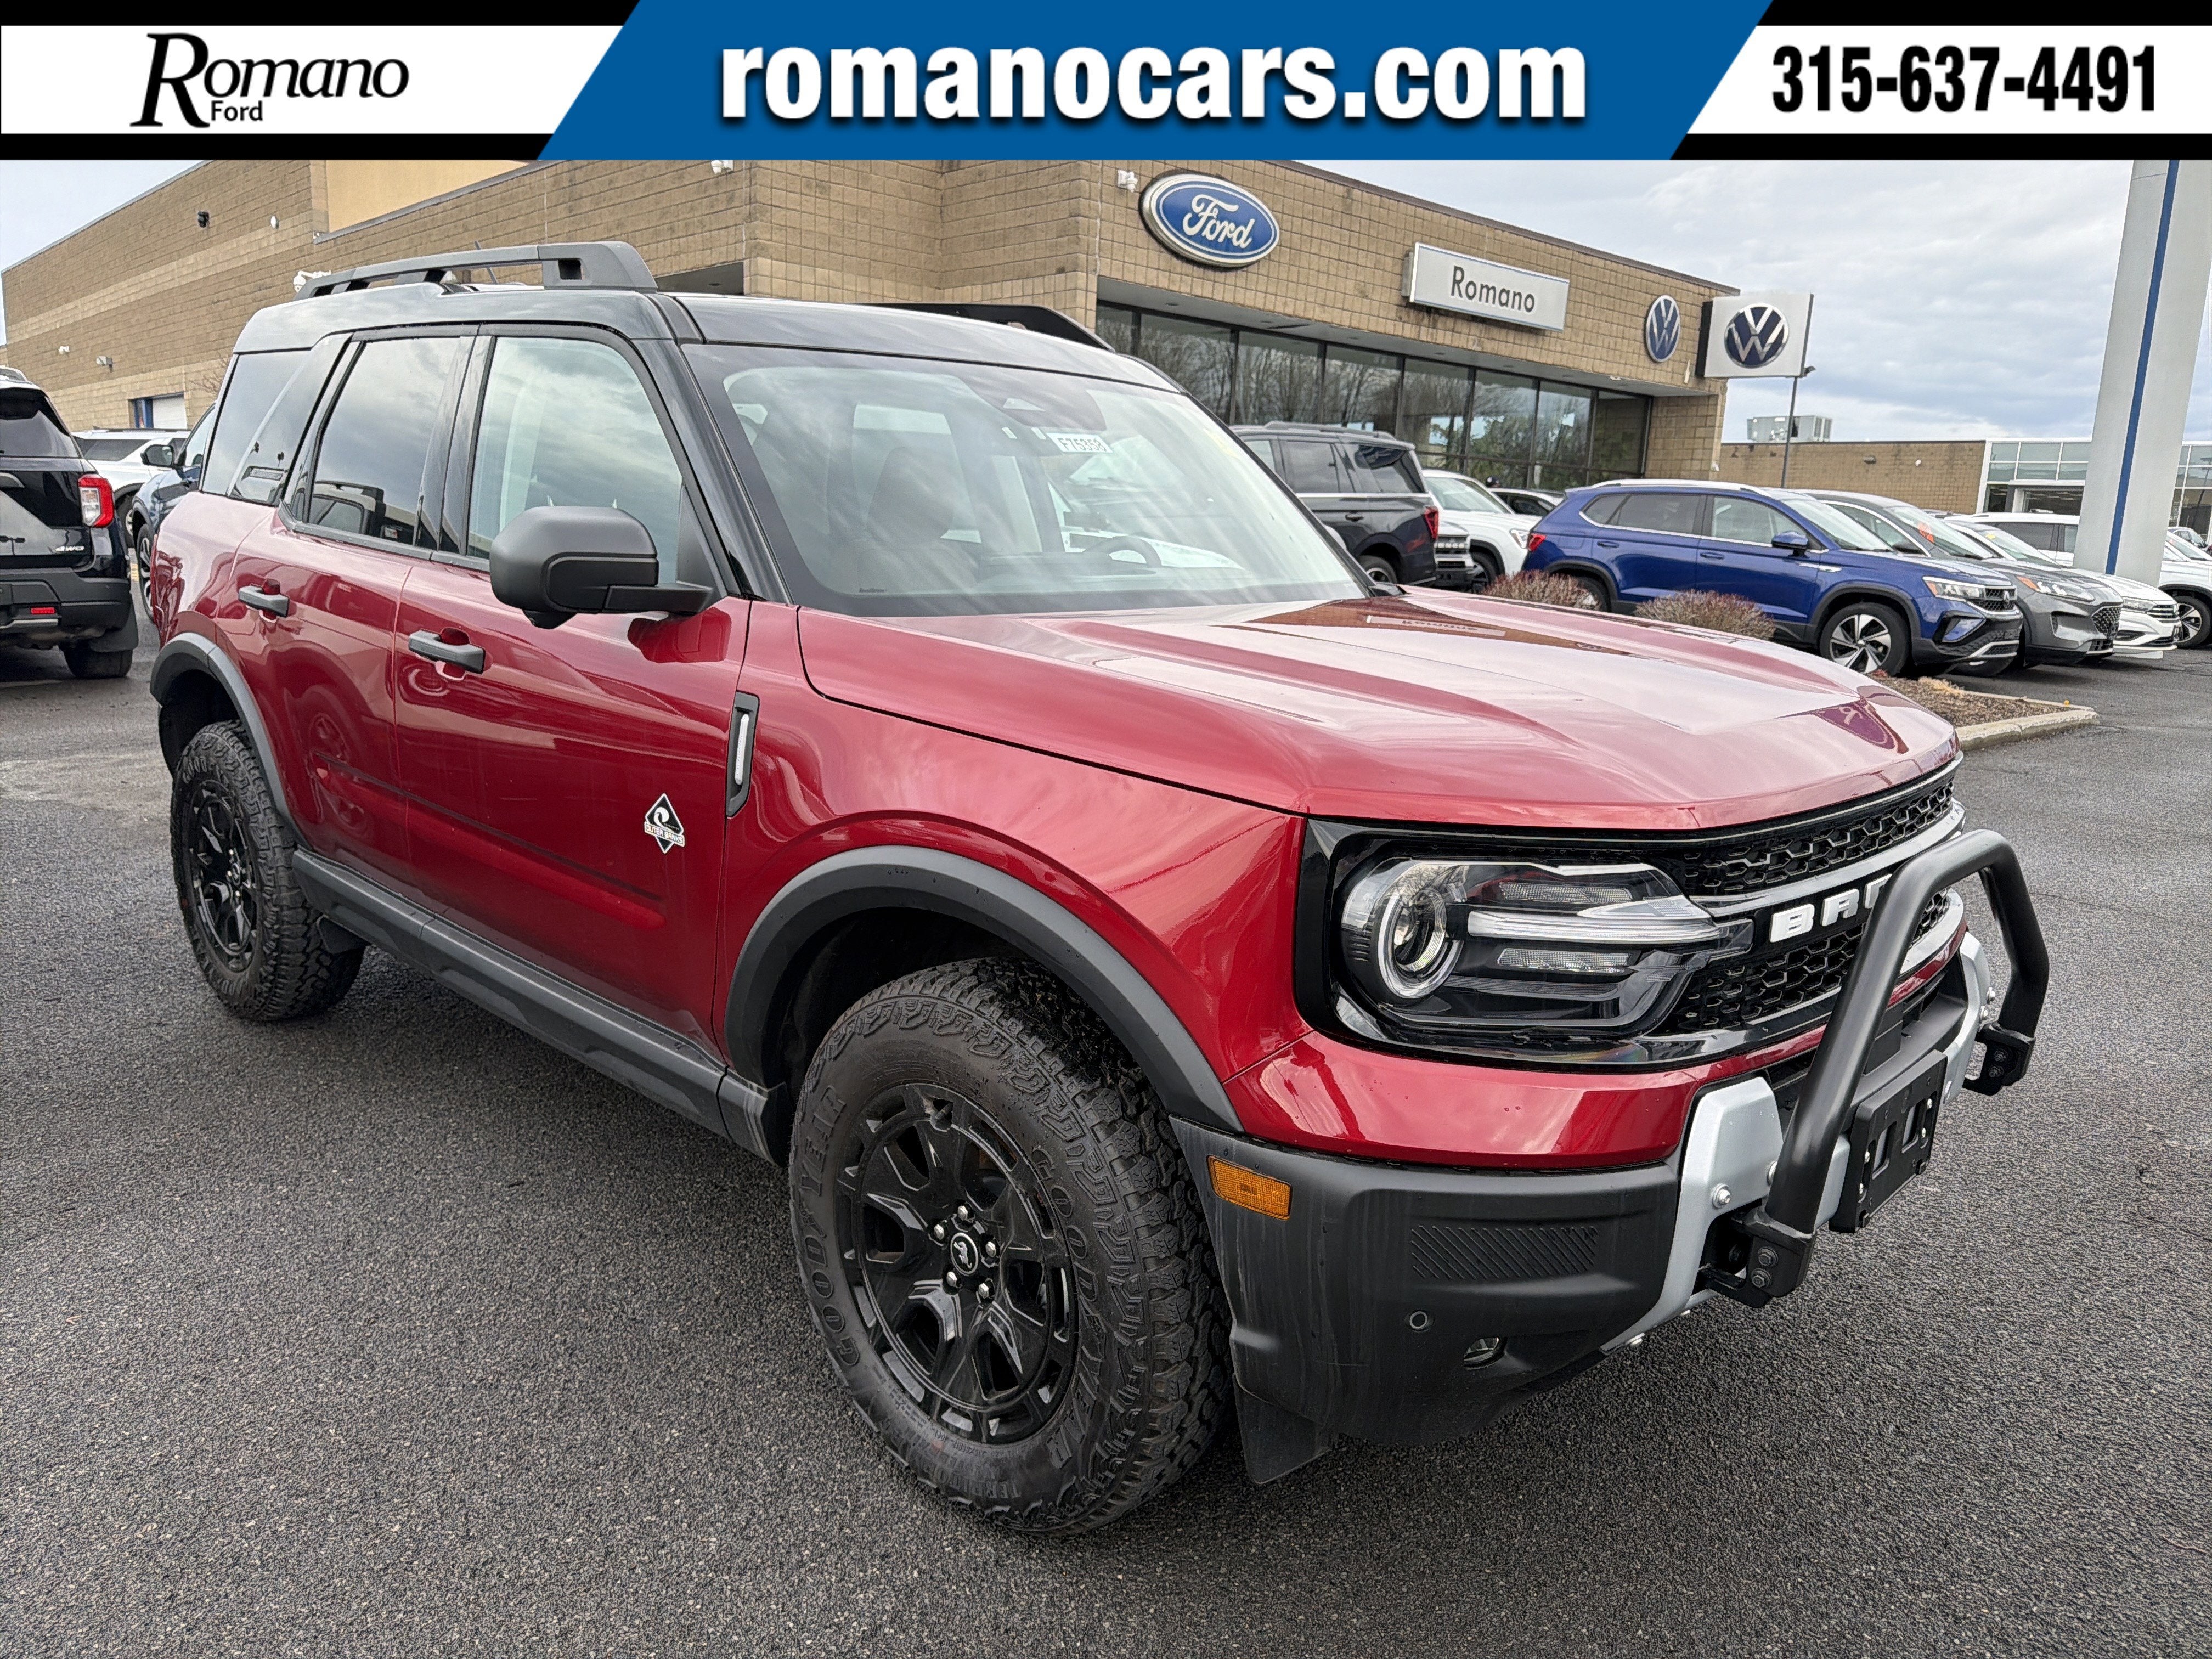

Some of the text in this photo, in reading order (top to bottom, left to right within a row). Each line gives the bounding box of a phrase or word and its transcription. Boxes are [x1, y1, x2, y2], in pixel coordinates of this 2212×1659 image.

[1183, 194, 1255, 248] Ford
[1451, 265, 1535, 313] Romano
[646, 825, 663, 837] OUTER
[664, 831, 683, 844] BANKS
